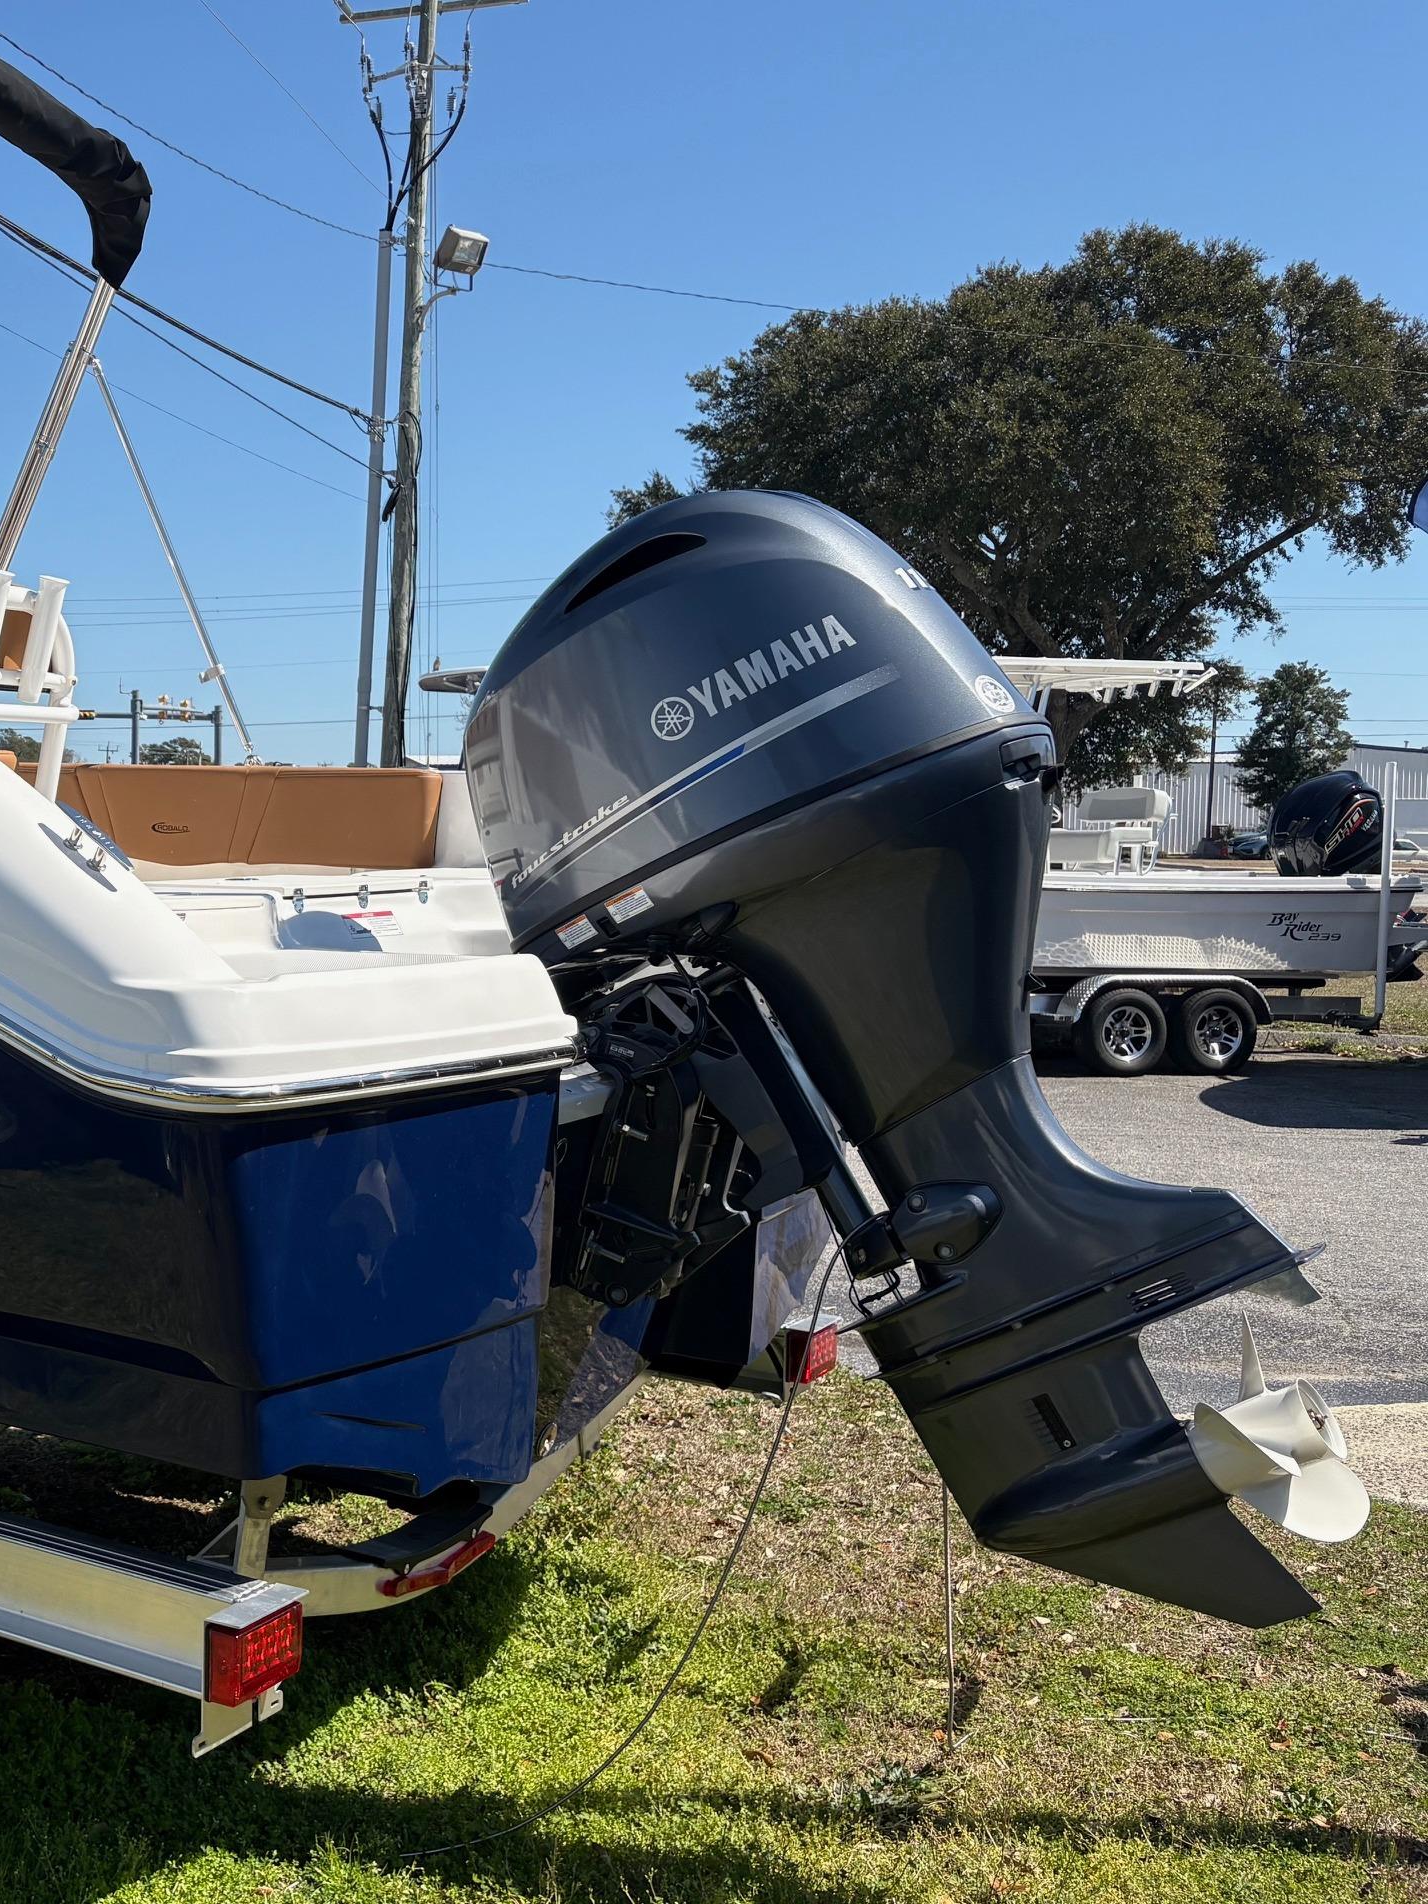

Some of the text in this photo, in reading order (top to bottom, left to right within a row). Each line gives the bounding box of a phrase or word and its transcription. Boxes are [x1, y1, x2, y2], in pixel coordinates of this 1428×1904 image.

[686, 614, 857, 718] YAMAHA
[1266, 912, 1300, 926] Bay
[1280, 921, 1323, 941] Rider
[1308, 932, 1342, 941] 239
